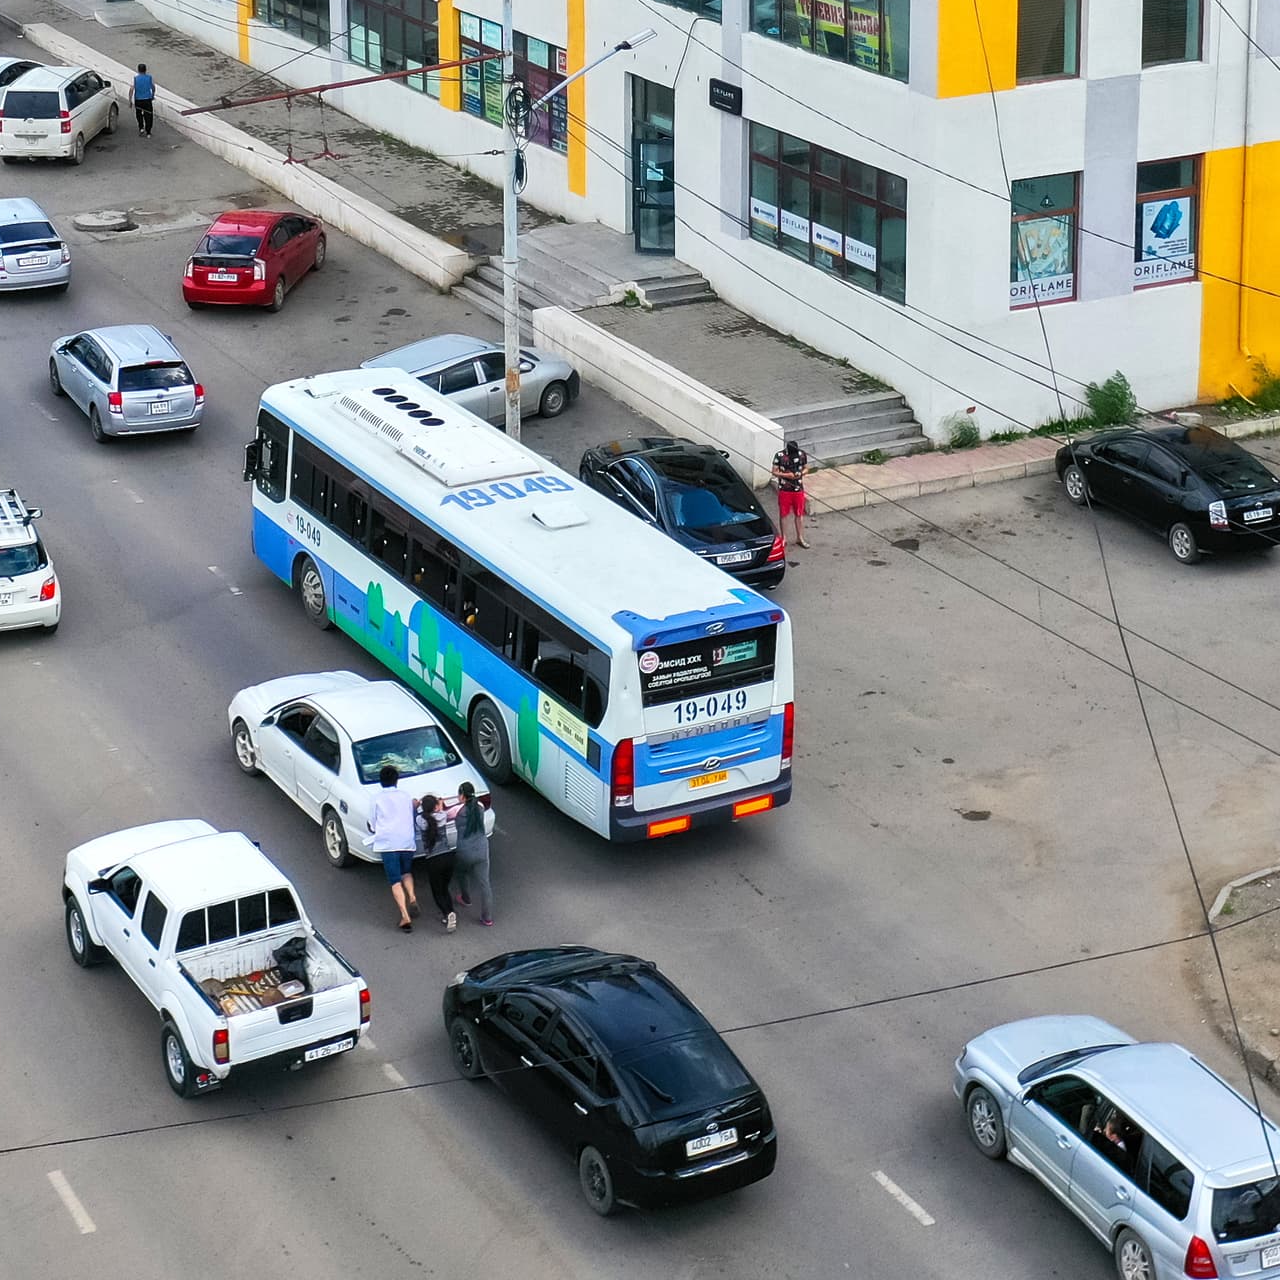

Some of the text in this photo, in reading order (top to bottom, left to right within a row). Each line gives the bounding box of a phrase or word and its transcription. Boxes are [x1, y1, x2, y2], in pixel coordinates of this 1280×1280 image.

[781, 216, 809, 234] ORIFLAME
[846, 243, 875, 262] ORIFLAME
[1134, 258, 1194, 277] ORIFLAME
[1010, 278, 1073, 297] ORIFLAME
[440, 475, 575, 511] 19-049
[296, 515, 321, 547] 19-049
[674, 690, 747, 724] 19-049
